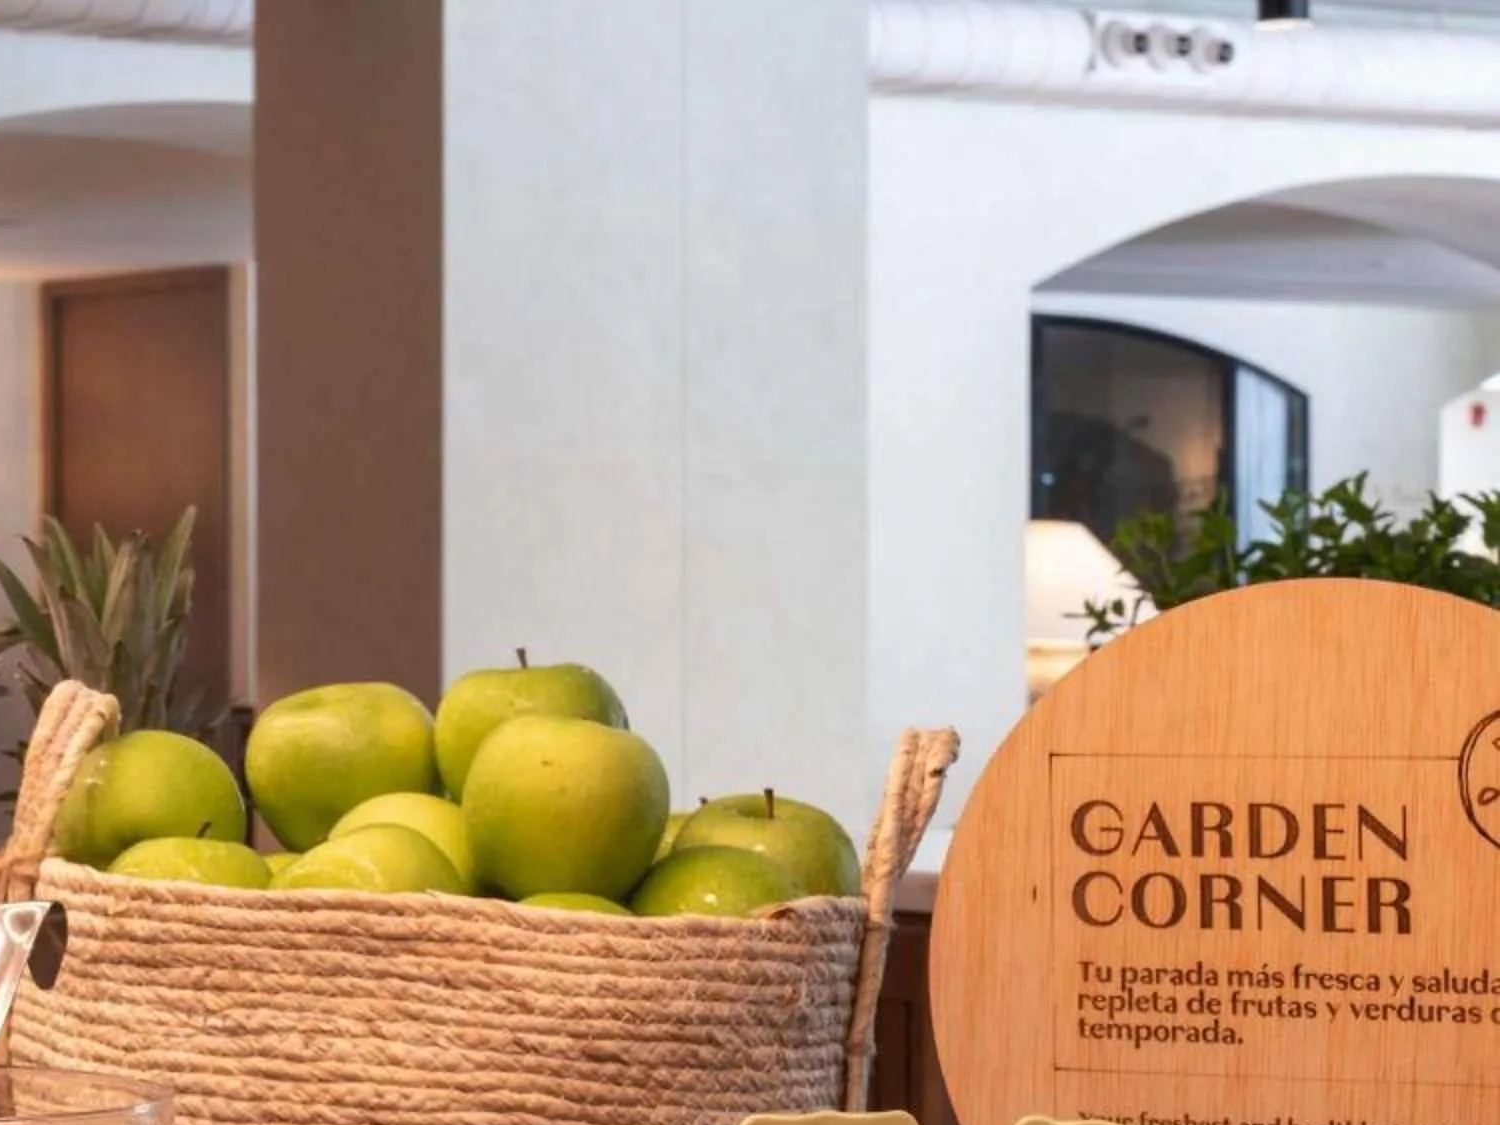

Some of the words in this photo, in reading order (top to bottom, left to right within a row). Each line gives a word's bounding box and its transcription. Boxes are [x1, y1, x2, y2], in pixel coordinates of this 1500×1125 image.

[1070, 800, 1408, 861] GARDEN
[1071, 870, 1412, 935] CORNER
[1077, 961, 1112, 983] Tu
[1120, 961, 1218, 992] parada
[1227, 963, 1285, 989] más
[1293, 962, 1380, 992] fresca
[1389, 974, 1405, 997] y
[1077, 987, 1178, 1020] repleta
[1186, 990, 1222, 1016] de
[1231, 991, 1317, 1019] frutas
[1326, 1001, 1341, 1024] y
[1350, 996, 1482, 1024] verduras
[1077, 1017, 1244, 1049] temporada.
